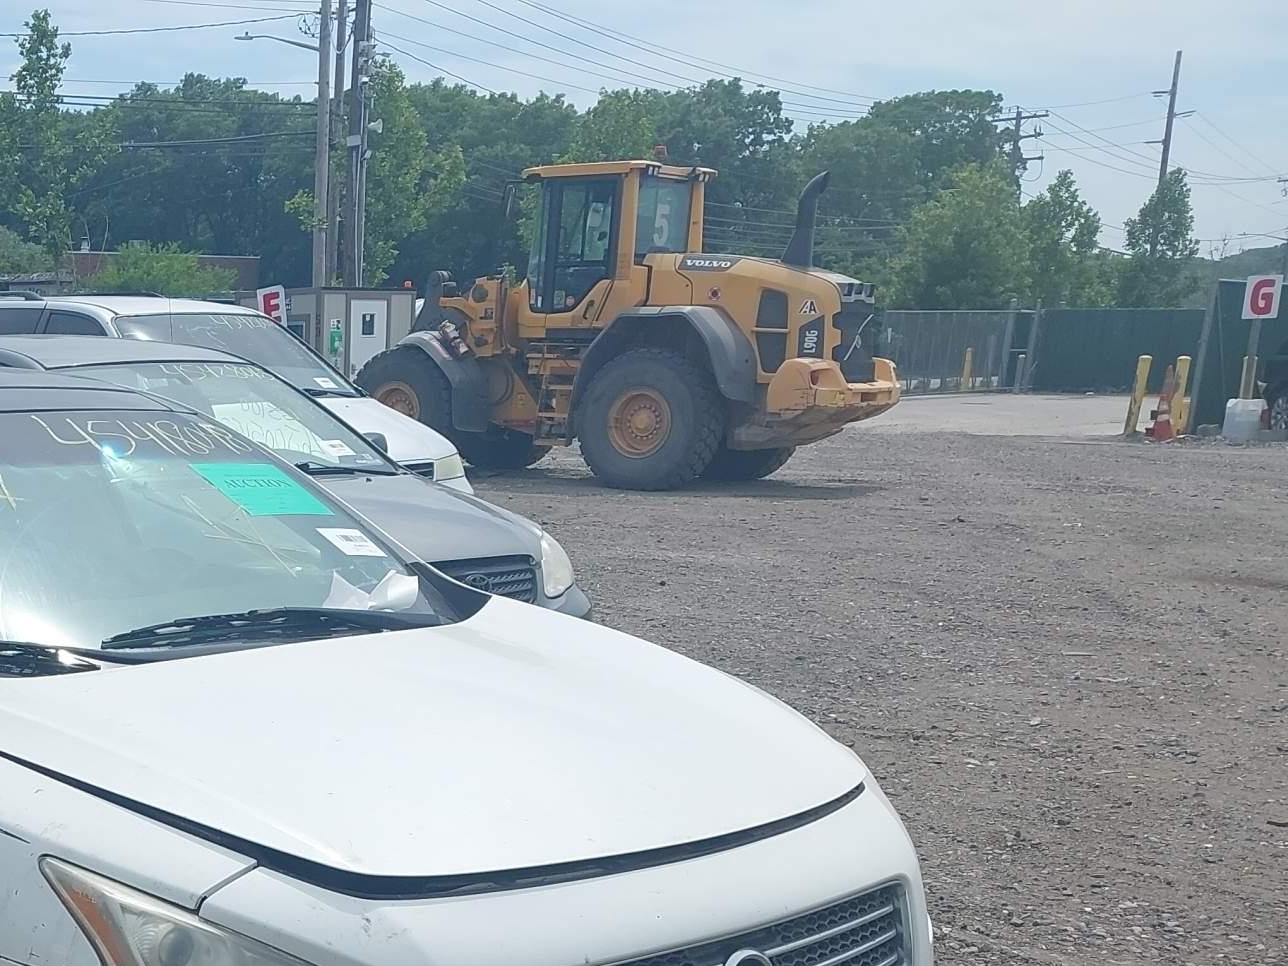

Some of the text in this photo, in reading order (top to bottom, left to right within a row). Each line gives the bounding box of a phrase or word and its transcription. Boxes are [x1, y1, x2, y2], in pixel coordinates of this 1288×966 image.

[653, 203, 671, 247] 5
[686, 259, 731, 268] VOLVO
[263, 291, 282, 322] E
[1250, 279, 1277, 316] G
[803, 330, 818, 353] L90G
[223, 478, 293, 489] AUCTION
